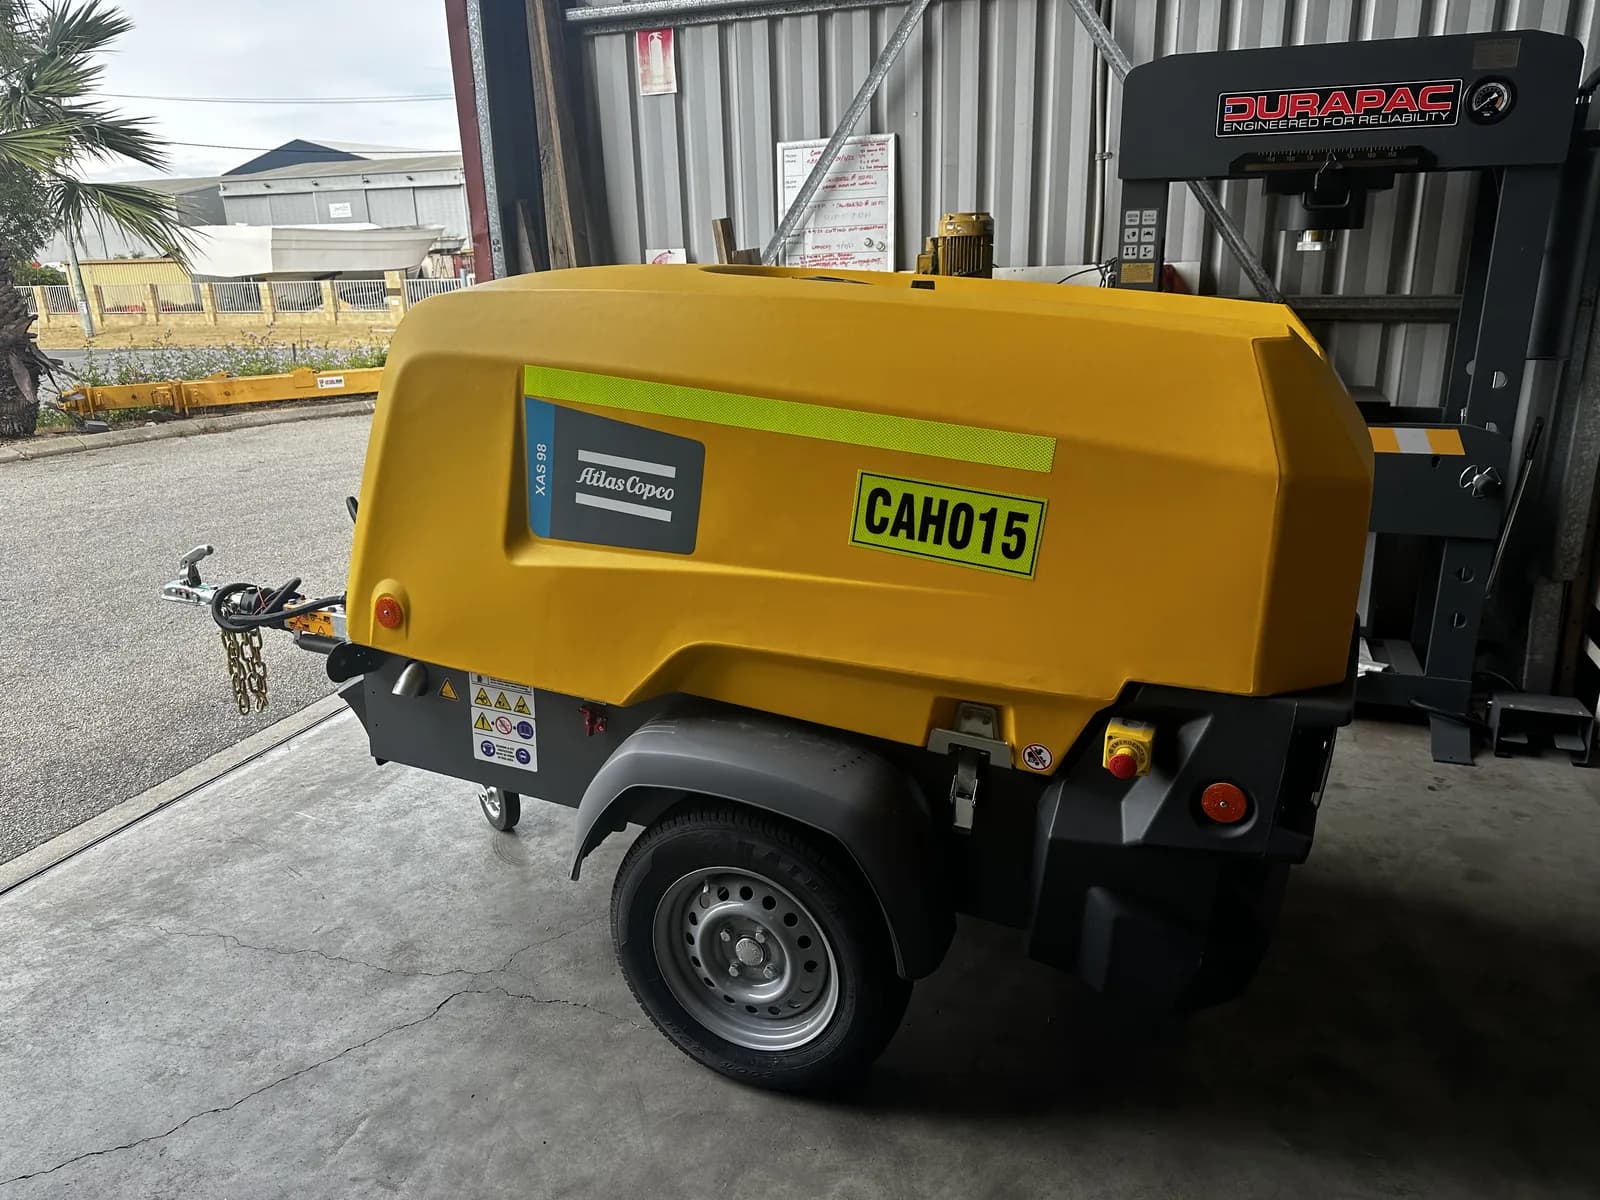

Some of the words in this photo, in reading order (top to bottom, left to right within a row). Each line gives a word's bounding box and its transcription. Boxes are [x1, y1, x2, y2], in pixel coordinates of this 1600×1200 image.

[1224, 84, 1455, 121] DURAPAC
[1223, 117, 1320, 132] ENGINEERED
[1323, 115, 1356, 127] FOR
[1358, 111, 1450, 125] RELIABILITY
[536, 443, 547, 461] 98
[535, 466, 546, 496] XAS
[576, 467, 625, 492] Atlas
[626, 476, 675, 501] Copco
[865, 487, 1029, 560] CAH015
